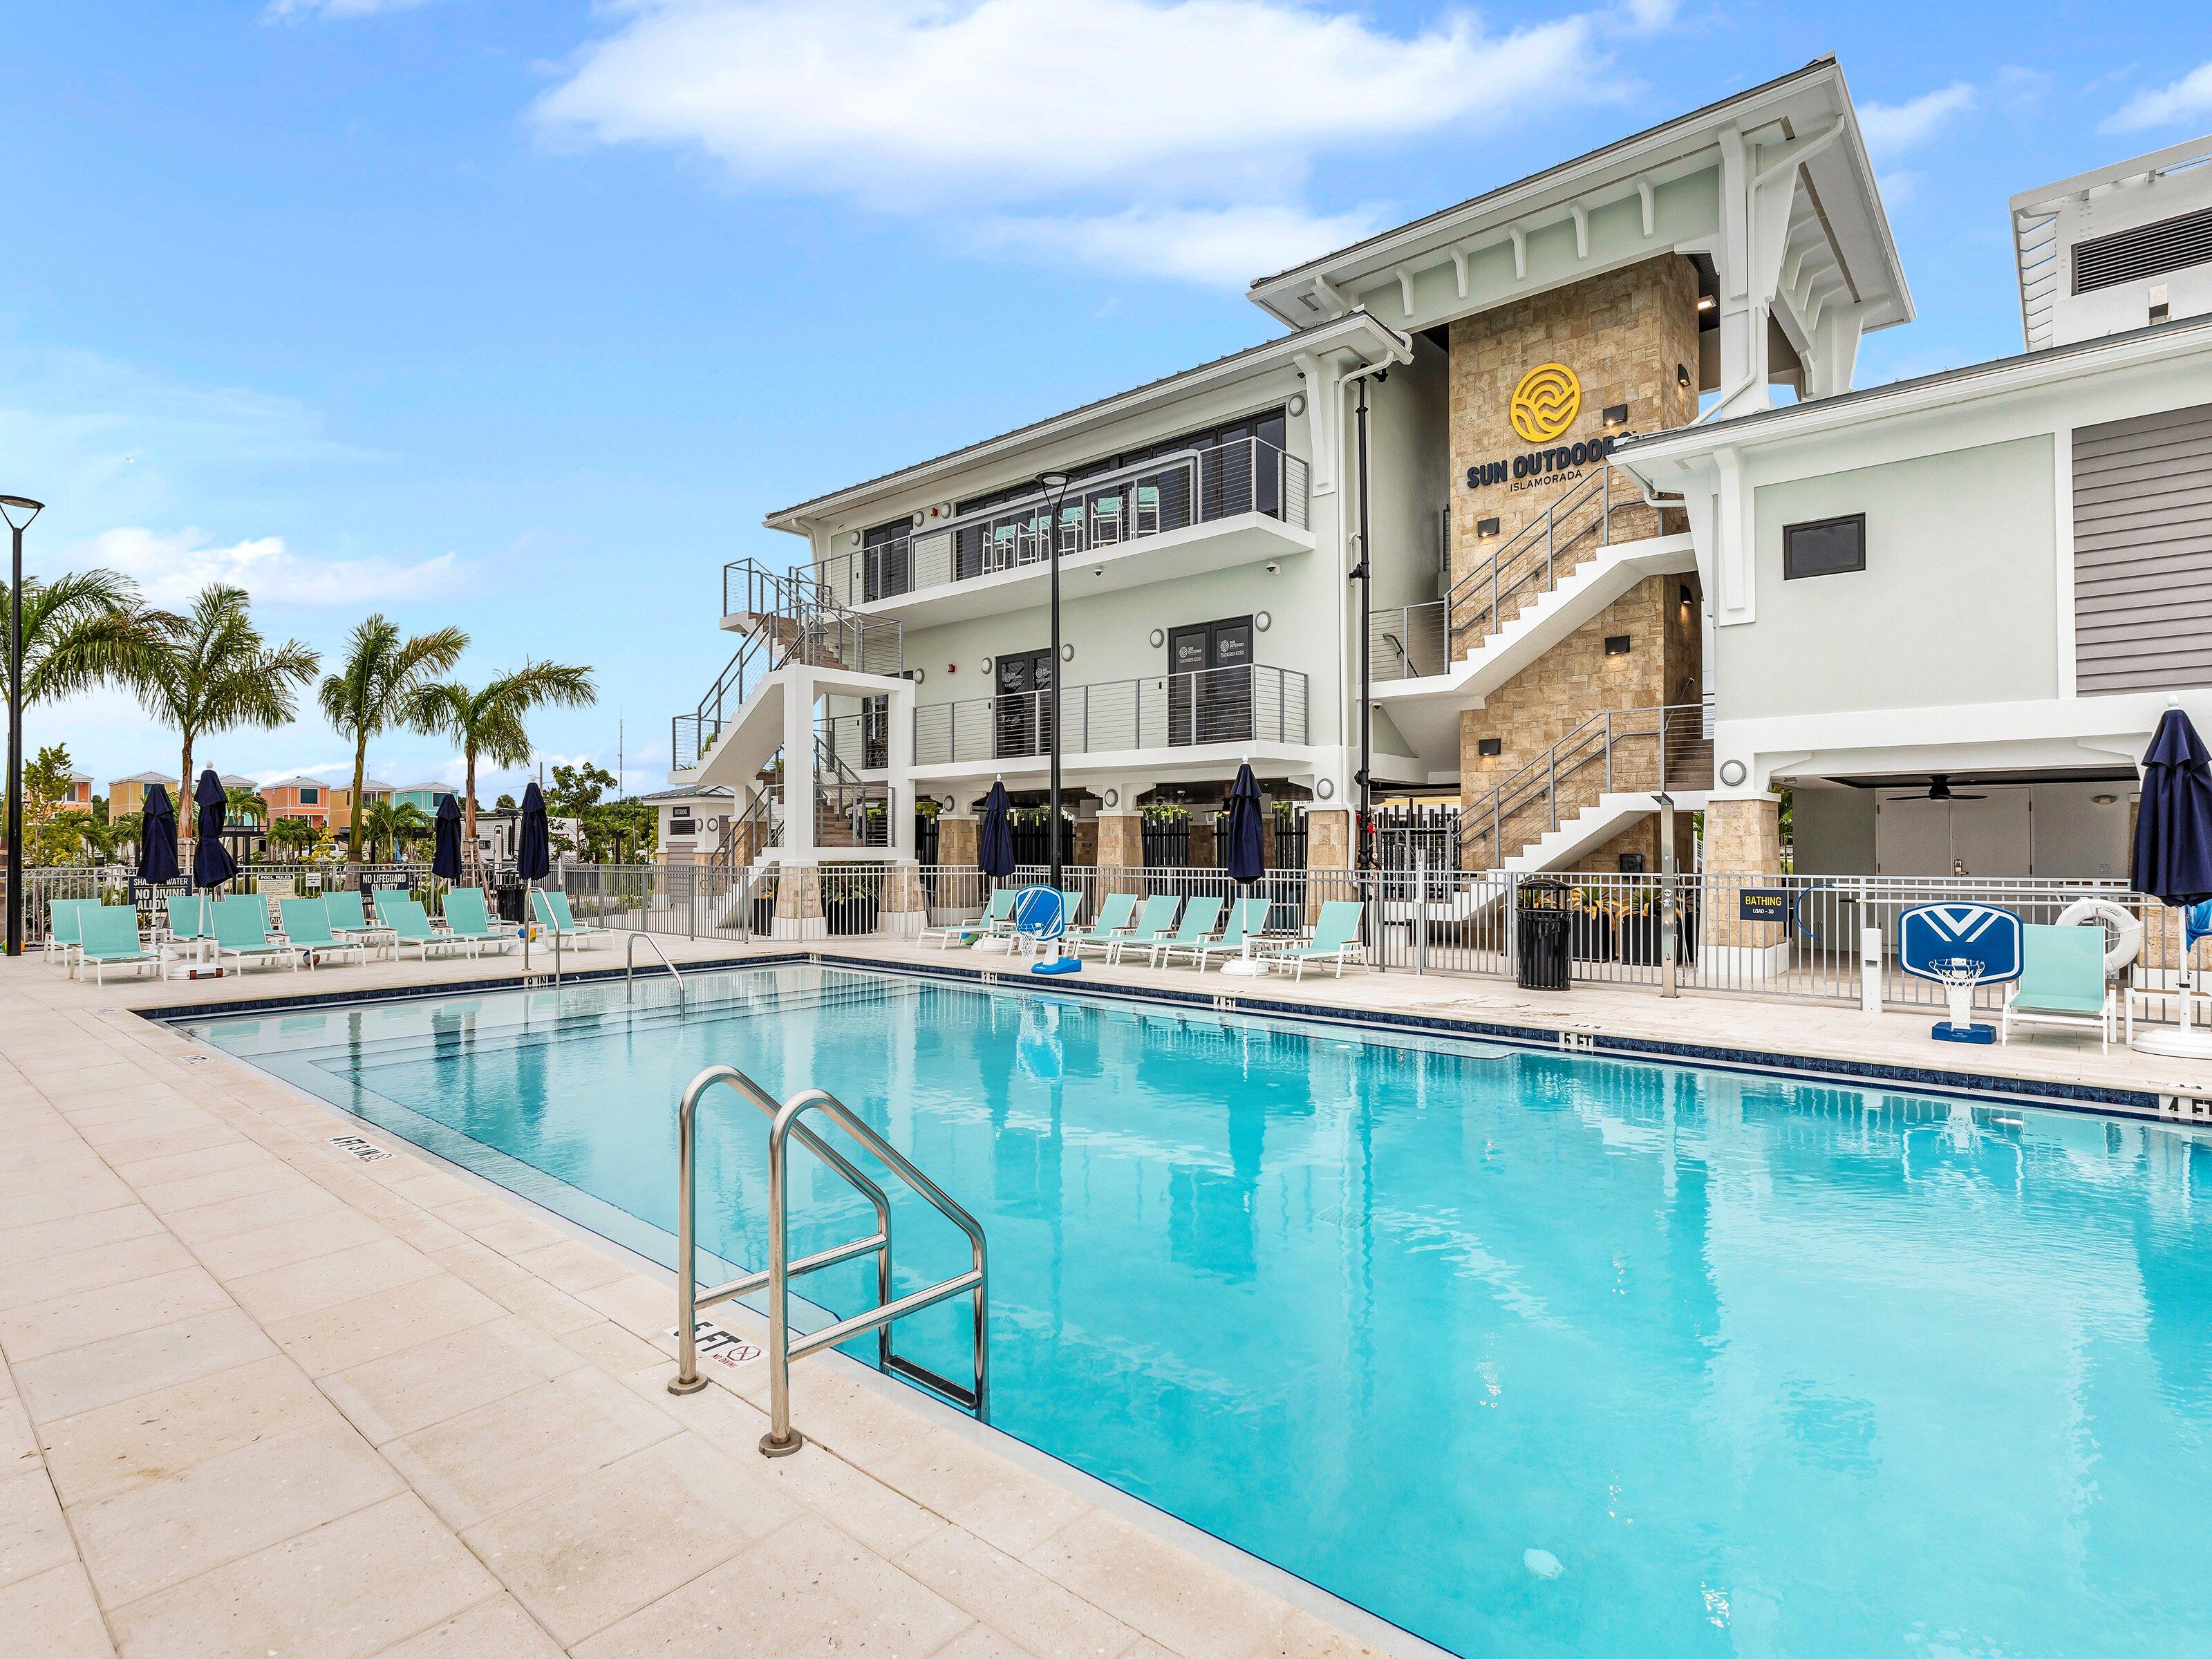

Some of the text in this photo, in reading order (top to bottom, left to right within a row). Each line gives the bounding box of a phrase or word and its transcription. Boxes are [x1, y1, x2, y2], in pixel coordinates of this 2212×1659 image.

[1467, 460, 1508, 489] SUN
[1510, 469, 1583, 492] ISLAMORADA
[166, 877, 188, 885] WATER
[362, 874, 406, 883] NO LIFEGUARD
[135, 889, 150, 899] NO
[1745, 896, 1782, 906] BATHING
[537, 975, 547, 984] IN
[1577, 1033, 1593, 1047] FT
[695, 1330, 743, 1353] FT
